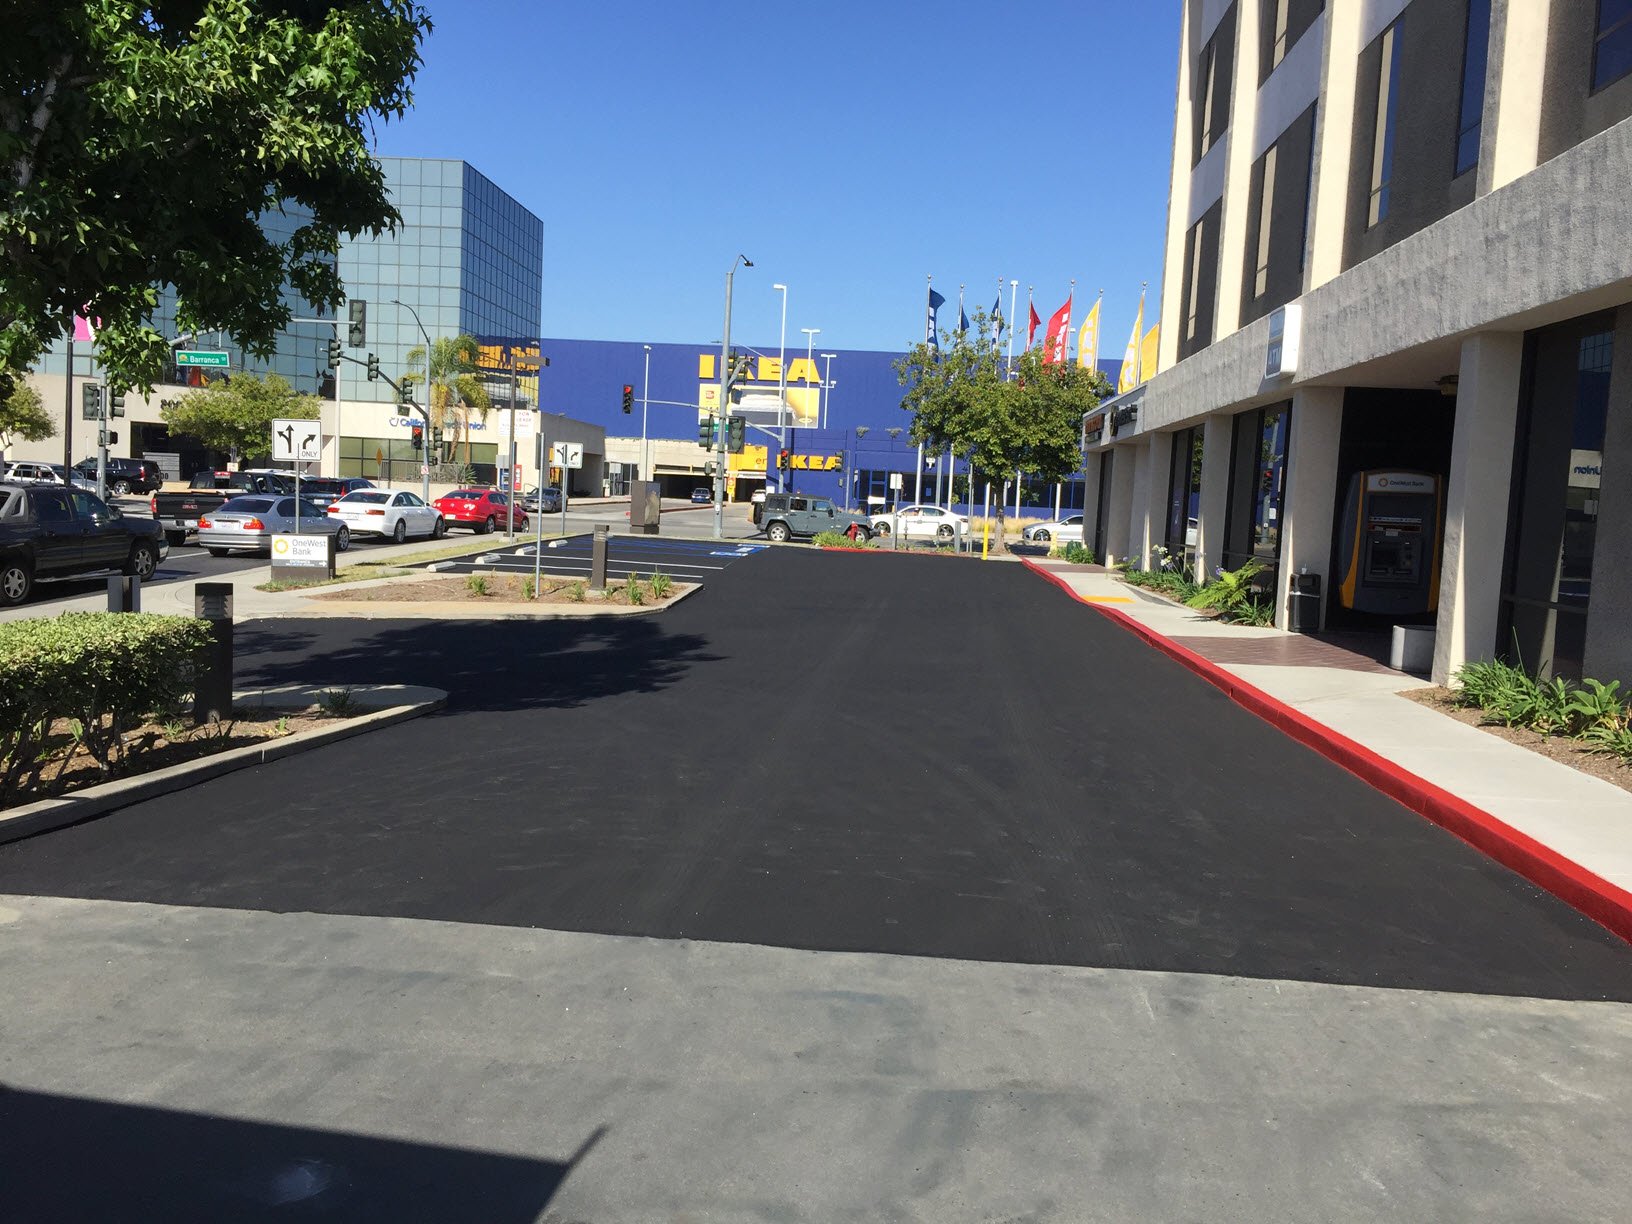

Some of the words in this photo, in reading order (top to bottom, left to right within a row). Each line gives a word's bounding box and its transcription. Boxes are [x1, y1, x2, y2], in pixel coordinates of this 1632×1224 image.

[190, 356, 220, 364] Barranca
[301, 450, 318, 458] ONLY
[776, 454, 838, 470] IKEA
[292, 539, 327, 548] OneWest
[292, 547, 312, 556] Bank
